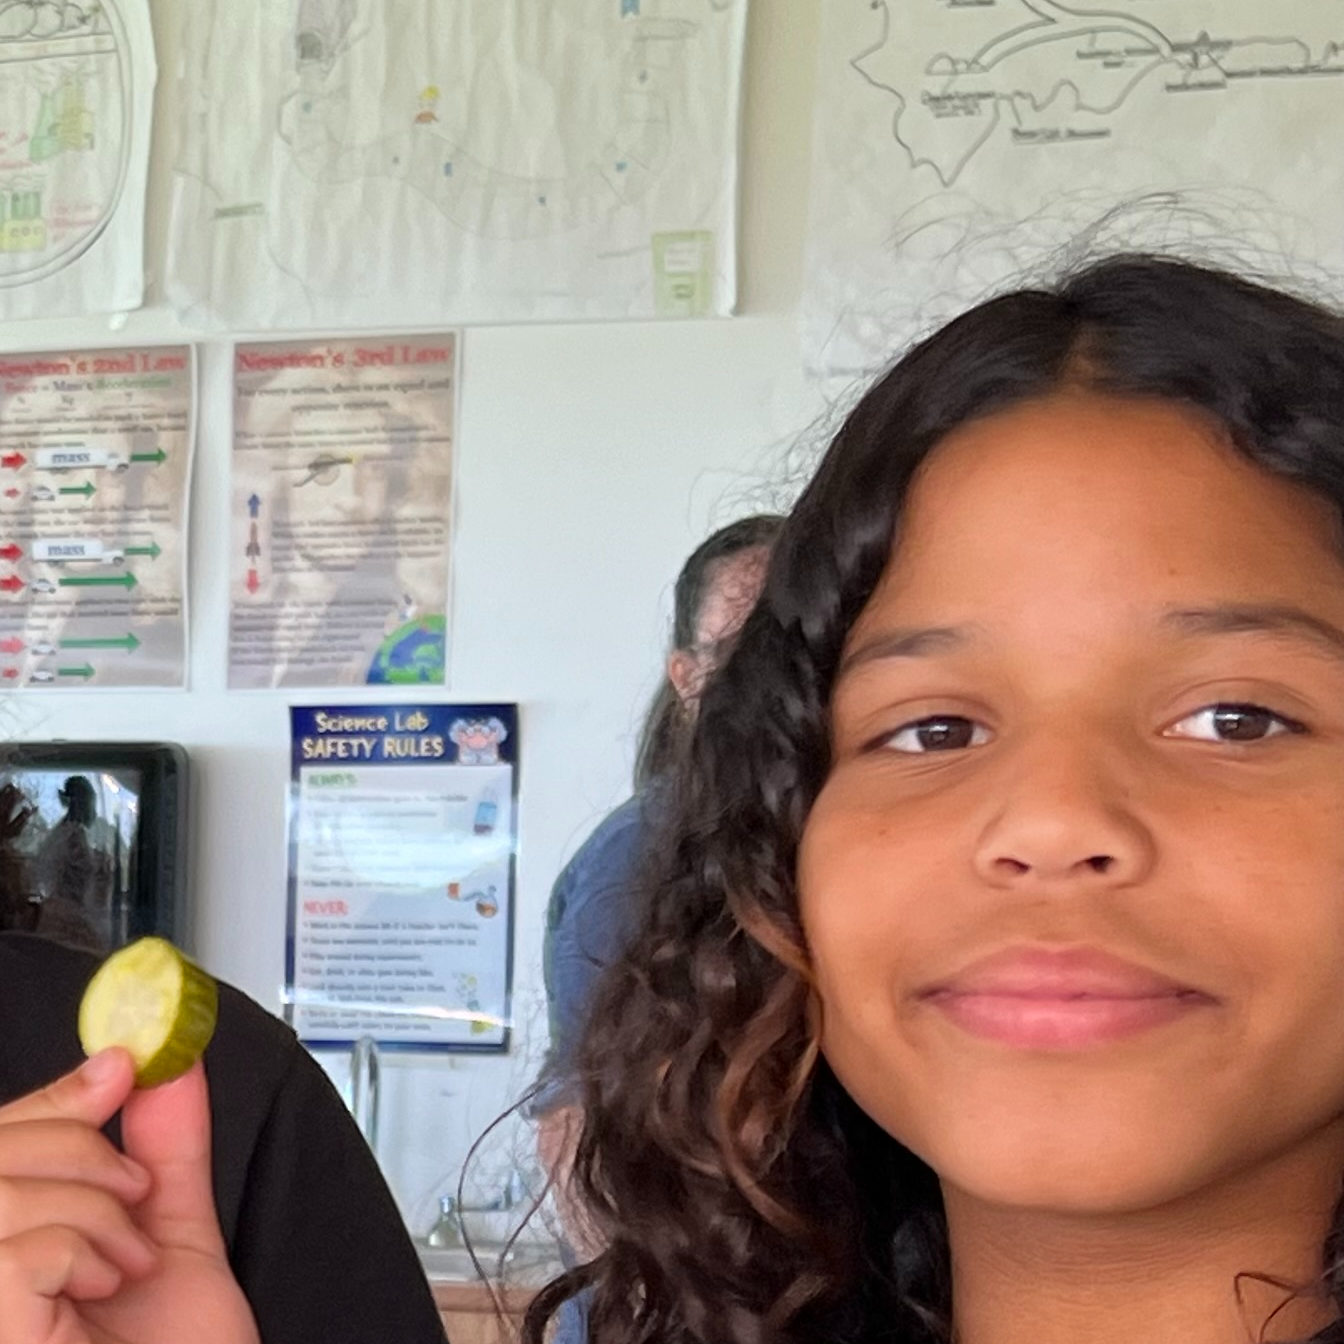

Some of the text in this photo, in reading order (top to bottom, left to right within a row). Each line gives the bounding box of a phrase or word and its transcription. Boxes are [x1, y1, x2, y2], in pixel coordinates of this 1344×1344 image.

[92, 352, 136, 375] 2nd
[140, 352, 188, 373] Law
[238, 346, 450, 371] Newton's 3rd Law
[51, 452, 91, 464] mass
[47, 545, 86, 556] mass
[315, 711, 429, 733] Science Lab
[301, 735, 445, 759] SAFETY RULES
